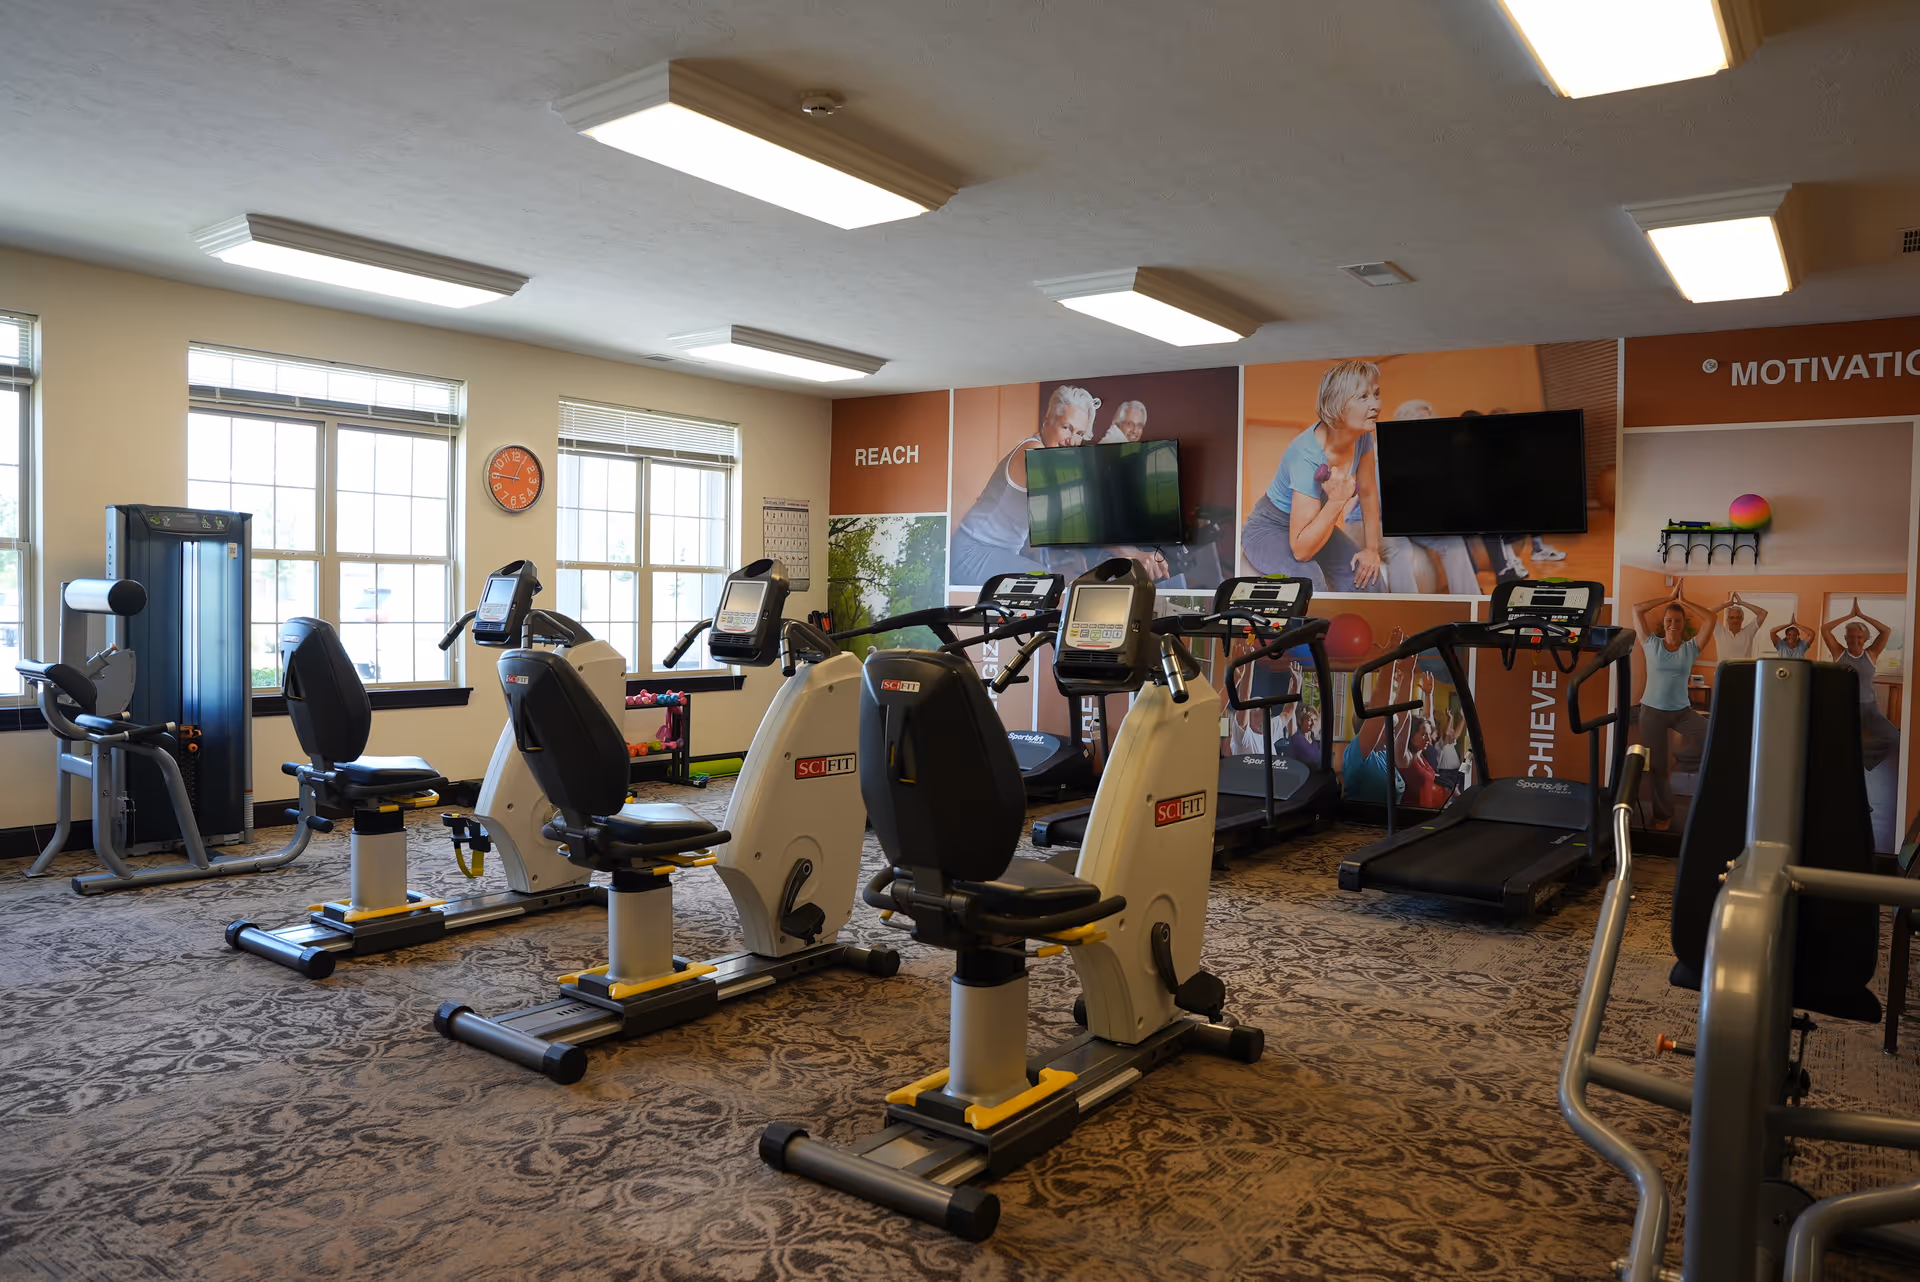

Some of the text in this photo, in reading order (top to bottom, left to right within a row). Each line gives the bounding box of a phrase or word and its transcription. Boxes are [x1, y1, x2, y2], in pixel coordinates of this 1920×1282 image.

[503, 453, 510, 463] 11
[512, 452, 520, 462] 12
[855, 444, 919, 467] REACH
[494, 459, 504, 470] 10
[527, 466, 535, 474] 2
[494, 483, 502, 491] 8
[527, 488, 533, 496] 4
[502, 491, 509, 500] 7
[511, 496, 516, 505] 6
[519, 494, 526, 503] 5
[883, 680, 919, 691] SCIFIT
[1007, 732, 1044, 741] SportsArt
[798, 757, 853, 775] SCIFIT
[1243, 755, 1287, 767] SporArt
[1516, 779, 1569, 791] SportsArt
[1158, 797, 1203, 821] SCIFIT
